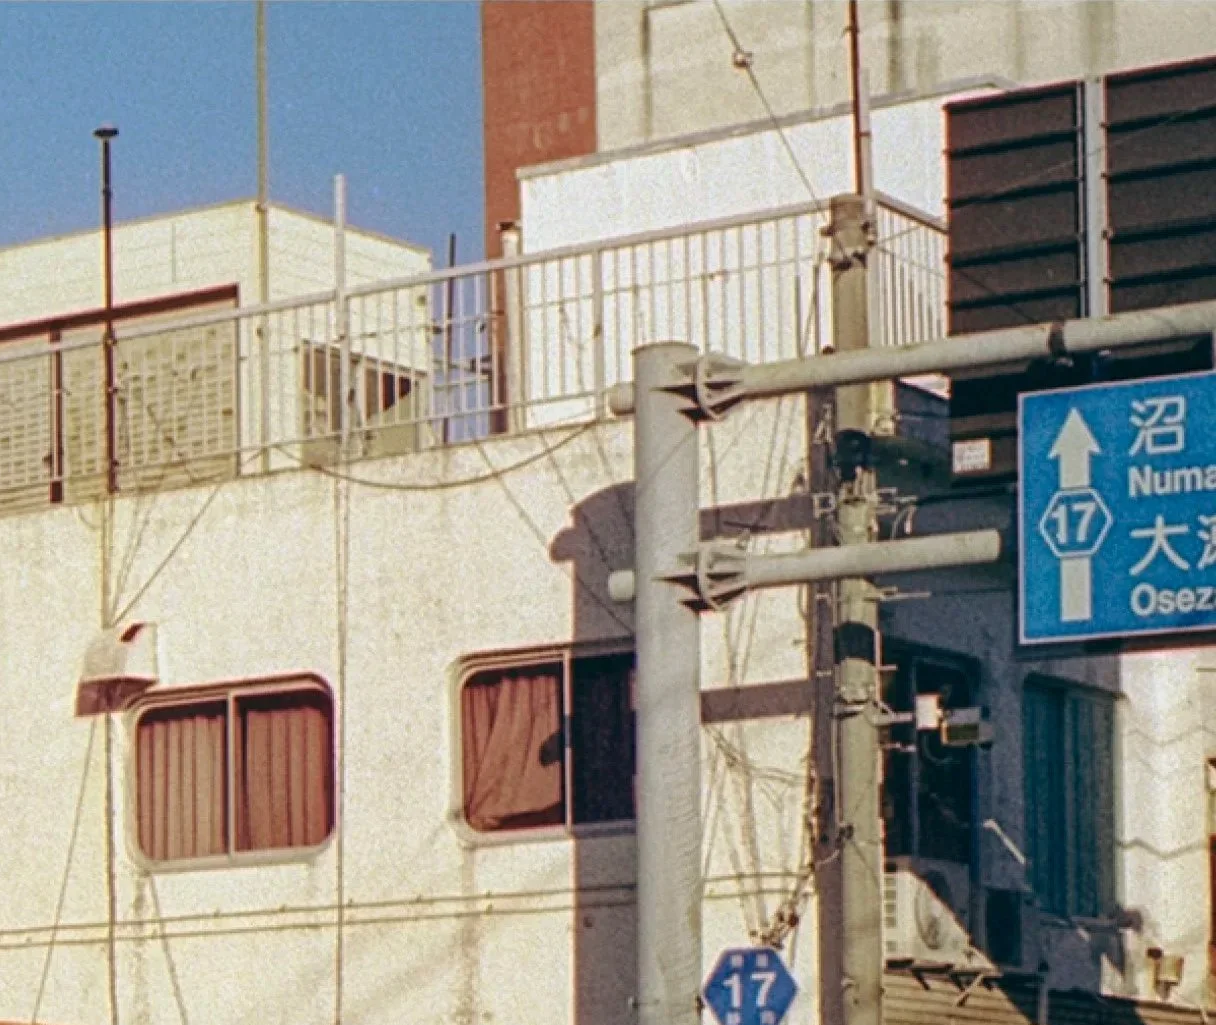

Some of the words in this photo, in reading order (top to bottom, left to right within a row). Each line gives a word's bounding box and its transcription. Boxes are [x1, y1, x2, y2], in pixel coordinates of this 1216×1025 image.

[1129, 395, 1186, 456] 沼
[1051, 502, 1098, 545] 17
[722, 970, 777, 1008] 17
